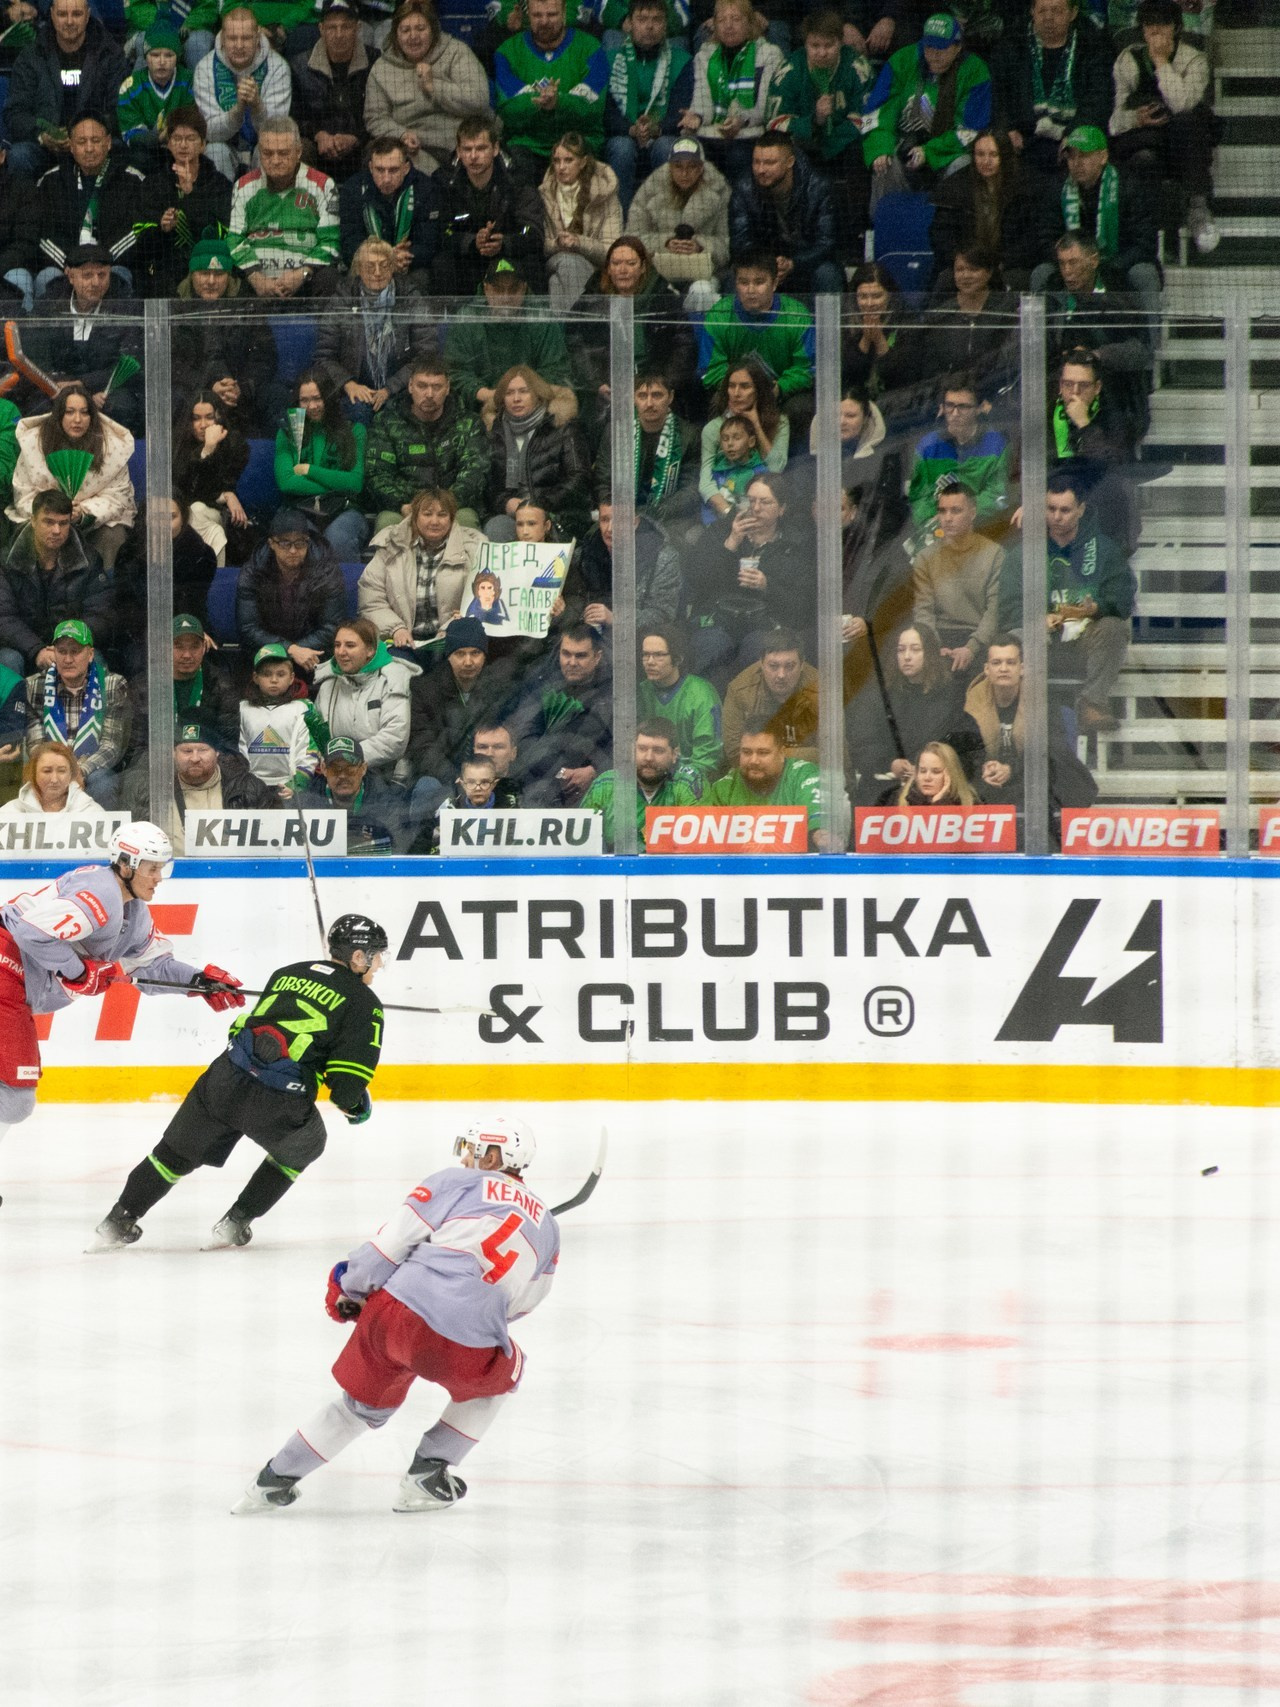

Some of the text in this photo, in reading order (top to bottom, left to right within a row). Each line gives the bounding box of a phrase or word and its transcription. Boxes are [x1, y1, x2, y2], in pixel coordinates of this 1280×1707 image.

[518, 611, 547, 632] ЮЛАЕ
[194, 818, 336, 847] KHL.RU
[450, 816, 594, 847] KHL.RU
[649, 814, 804, 845] FONBET
[860, 813, 1014, 845] FONBET
[1064, 816, 1218, 848] FONBET
[53, 913, 82, 941] 13
[396, 897, 992, 961] ATRIBUTIKA
[272, 976, 346, 1012] ORSHKOV
[478, 982, 544, 1044] &
[578, 981, 830, 1042] CLUB
[486, 1180, 545, 1225] KEANE
[480, 1212, 525, 1285] 4
